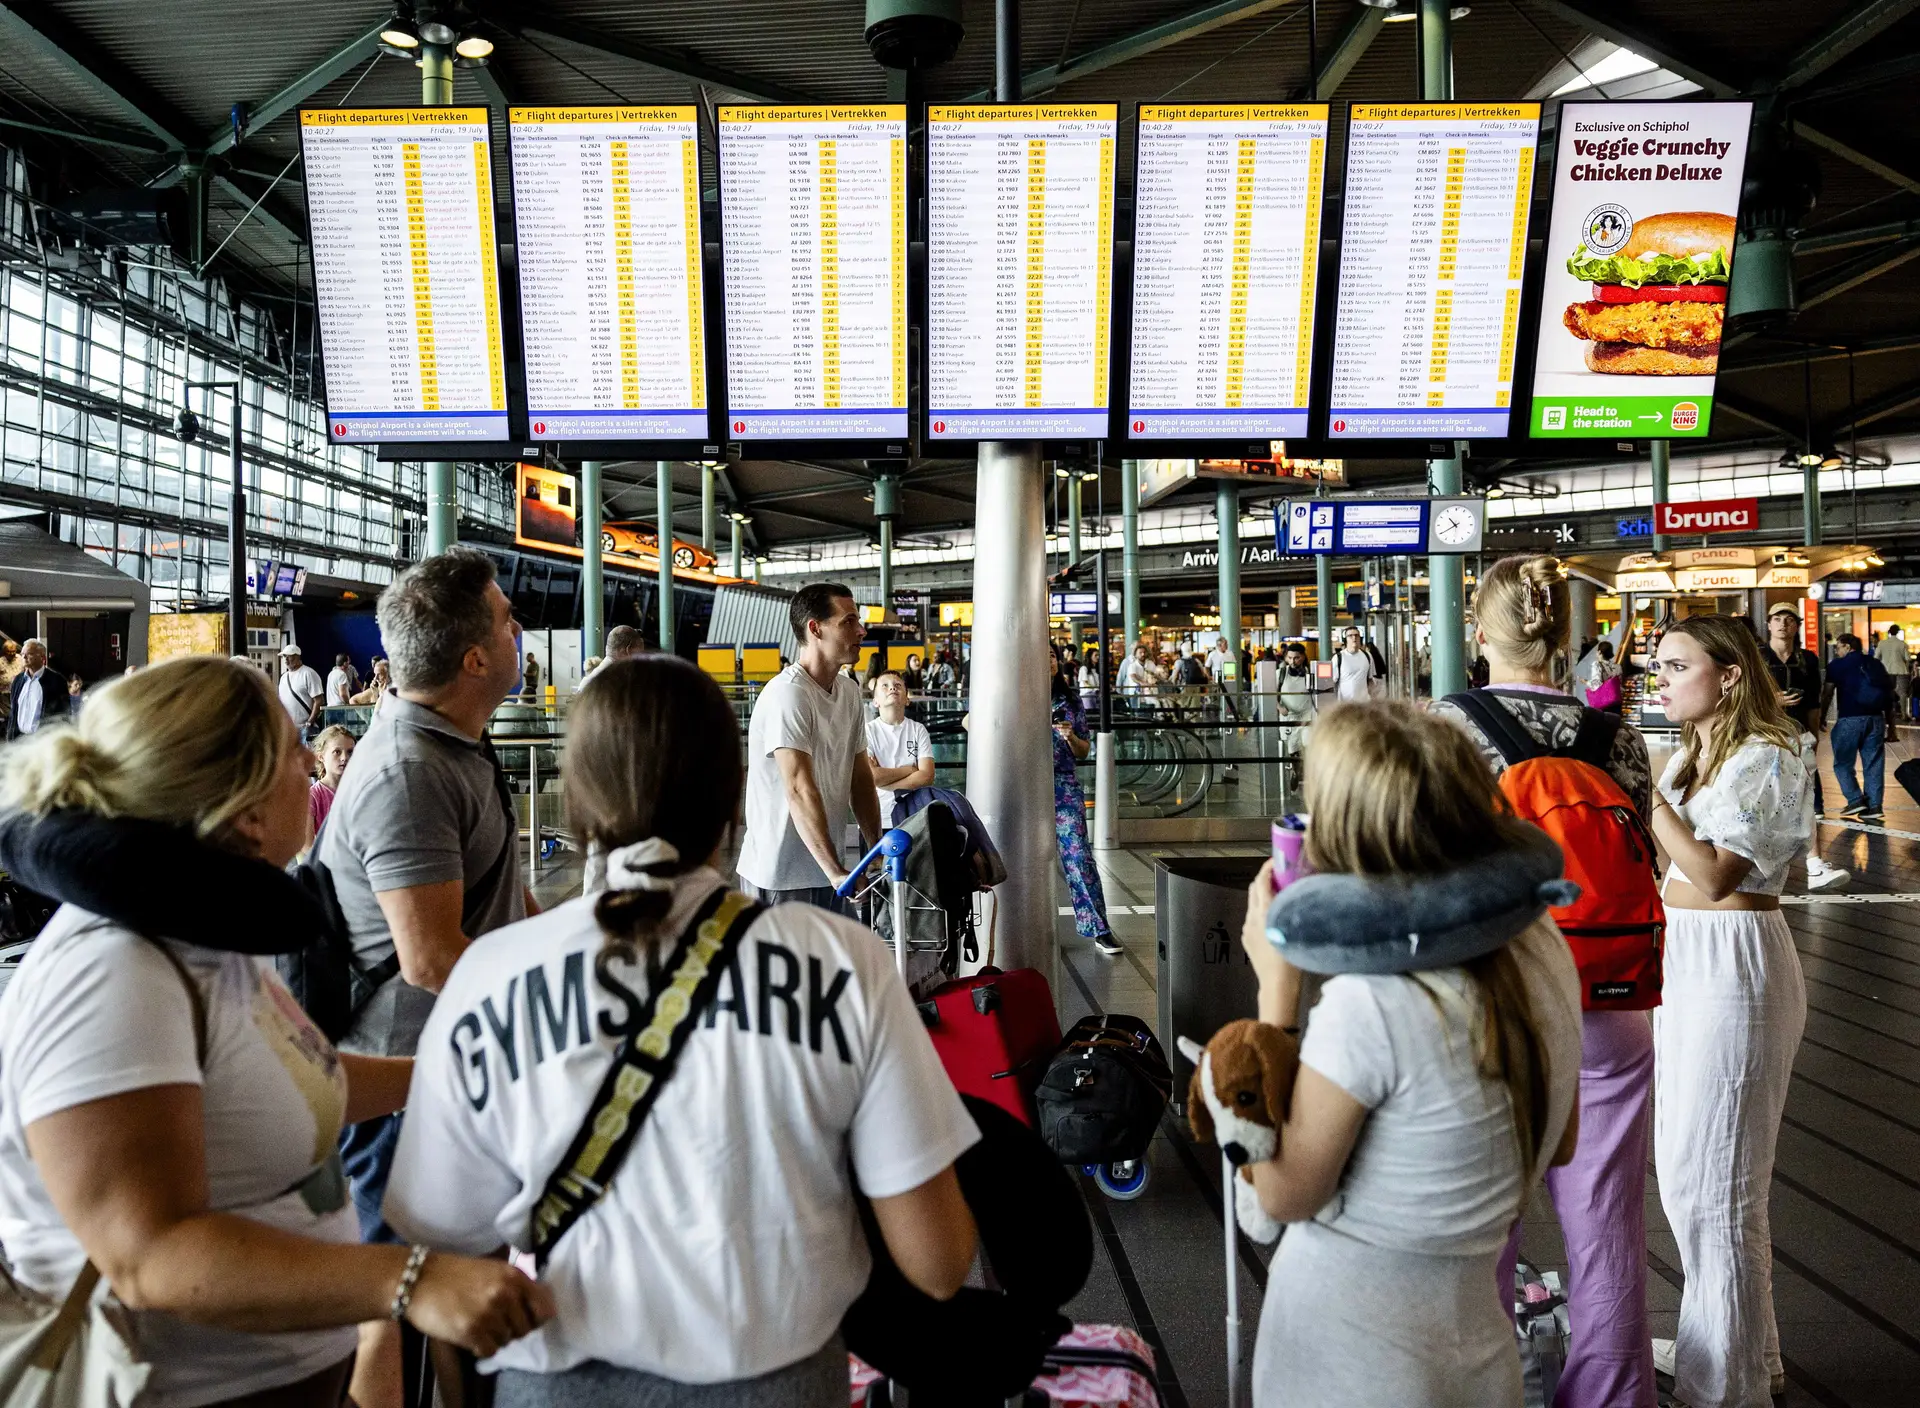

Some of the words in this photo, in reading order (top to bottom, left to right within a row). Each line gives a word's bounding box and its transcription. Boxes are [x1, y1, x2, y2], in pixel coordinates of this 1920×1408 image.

[318, 113, 347, 124] Flight
[350, 113, 404, 123] departures
[412, 112, 467, 121] Vertrekken
[527, 111, 555, 122] Flight
[559, 111, 613, 121] departures
[621, 110, 677, 119] Vertrekken
[737, 110, 765, 121] Flight
[768, 110, 822, 120] departures
[831, 109, 886, 118] Vertrekken
[947, 110, 975, 120] Flight
[978, 109, 1033, 120] departures
[1042, 108, 1097, 117] Vertrekken
[1158, 109, 1186, 120] Flight
[1189, 109, 1244, 119] departures
[1253, 108, 1308, 117] Vertrekken
[1369, 108, 1398, 119] Flight
[1401, 108, 1455, 118] departures
[1465, 108, 1520, 116] Vertrekken
[303, 128, 334, 136] 10:40:27
[468, 127, 483, 135] July
[678, 125, 692, 134] July
[1058, 123, 1083, 131] Friday,
[1097, 123, 1111, 131] July
[1269, 123, 1294, 131] Friday,
[1308, 123, 1322, 131] July
[1480, 122, 1504, 130] Friday,
[1519, 122, 1534, 130] July
[1575, 122, 1625, 133] Exclusive
[1627, 124, 1640, 132] on
[1643, 121, 1689, 133] Schiphol
[1574, 137, 1639, 161] Veggie
[1643, 137, 1731, 159] Crunchy
[1571, 163, 1652, 181] Chicken
[1656, 164, 1723, 181] Deluxe
[1593, 205, 1619, 216] POWERED
[1574, 406, 1603, 416] Head
[1605, 407, 1617, 416] to
[348, 422, 378, 430] Schiphol
[381, 422, 407, 430] Airport
[443, 421, 472, 429] airport.
[748, 420, 778, 428] Schiphol
[781, 419, 806, 428] Airport
[843, 419, 871, 427] airport.
[948, 419, 978, 428] Schiphol
[980, 419, 1007, 427] Airport
[1042, 418, 1072, 427] airport.
[1348, 419, 1379, 427] Schiphol
[1381, 418, 1407, 427] Airport
[1443, 418, 1472, 426] airport.
[1573, 418, 1591, 428] the
[1594, 418, 1632, 428] station
[1673, 416, 1696, 424] KING
[361, 429, 381, 437] flight
[760, 427, 779, 435] flight
[960, 427, 979, 435] flight
[1360, 426, 1380, 434] flight
[1318, 513, 1327, 525] 3
[1664, 506, 1748, 529] bruna
[1317, 536, 1326, 547] 4
[1625, 577, 1659, 589] bruna
[1692, 573, 1740, 586] bruna
[1771, 571, 1803, 584] bruna
[269, 604, 281, 617] wall
[450, 939, 854, 1113] GYMSARK
